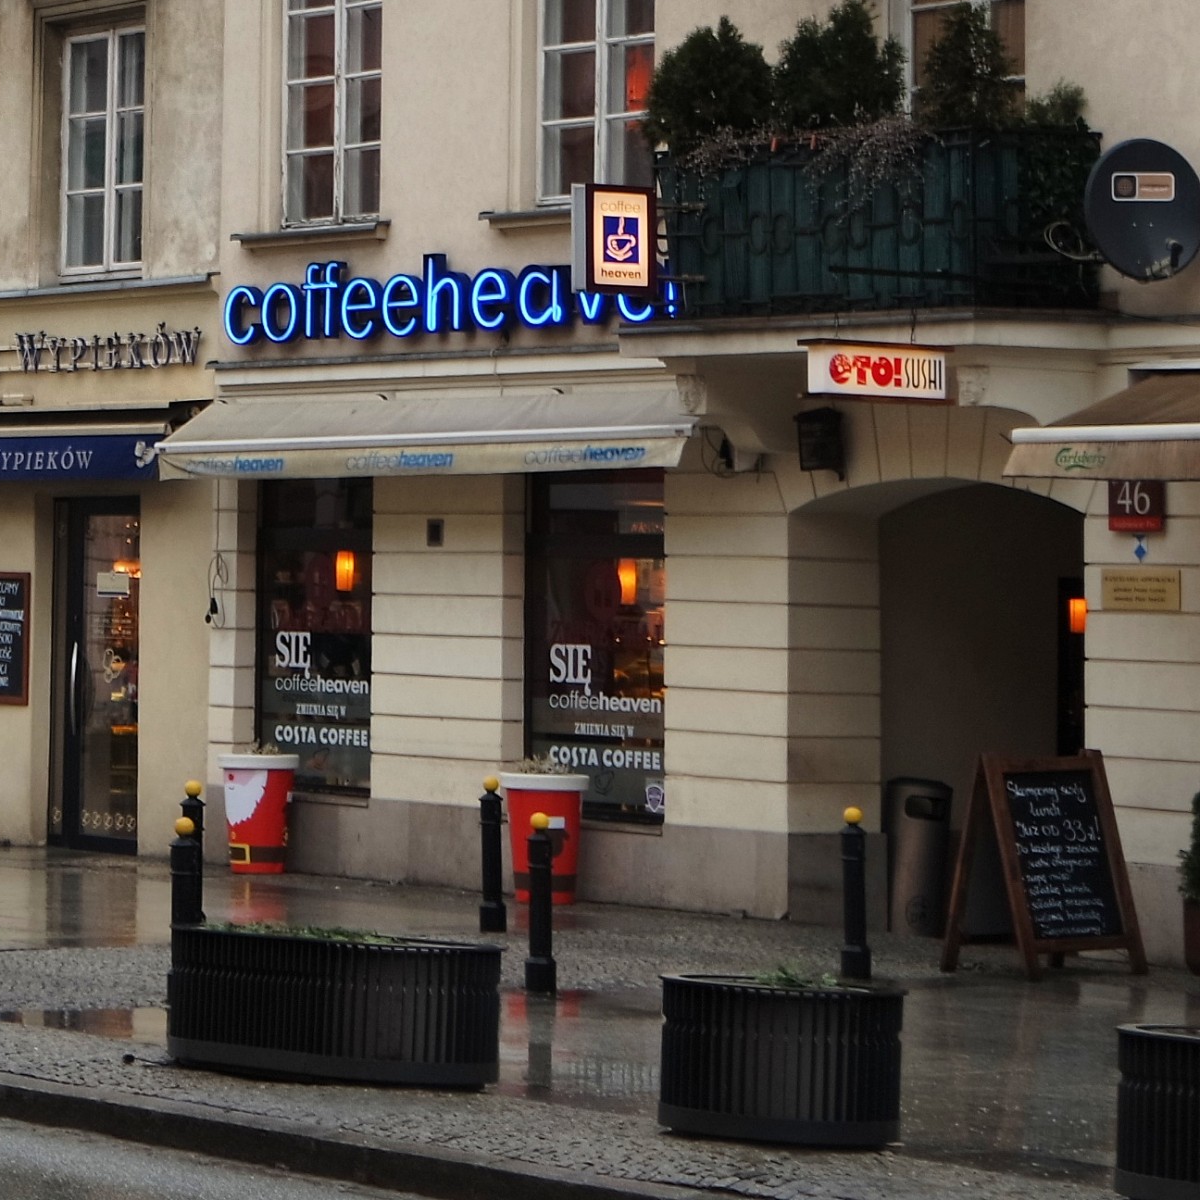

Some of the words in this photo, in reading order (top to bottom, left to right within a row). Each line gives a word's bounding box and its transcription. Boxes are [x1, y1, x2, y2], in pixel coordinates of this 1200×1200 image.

[600, 200, 641, 213] coffee
[601, 268, 641, 280] heaven
[829, 353, 902, 388] OTO!
[904, 357, 942, 390] SUSHI
[345, 450, 454, 471] coffeeheaven
[1117, 481, 1151, 515] 46
[275, 631, 311, 678] SIĘ
[550, 643, 591, 696] SIĘ
[275, 675, 368, 695] coffeeheaven
[296, 703, 326, 716] ZMIENIA
[326, 704, 340, 719] SIĘ
[340, 705, 347, 717] W
[550, 690, 661, 714] coffeeheaven
[275, 724, 317, 745] COSTA
[319, 727, 368, 747] COFFEE
[574, 722, 609, 736] ZMIENIA
[611, 724, 626, 740] SIĘ
[627, 725, 635, 737] W
[550, 745, 598, 767] COSTA
[602, 749, 661, 771] COFFEE
[1063, 819, 1087, 842] 33
